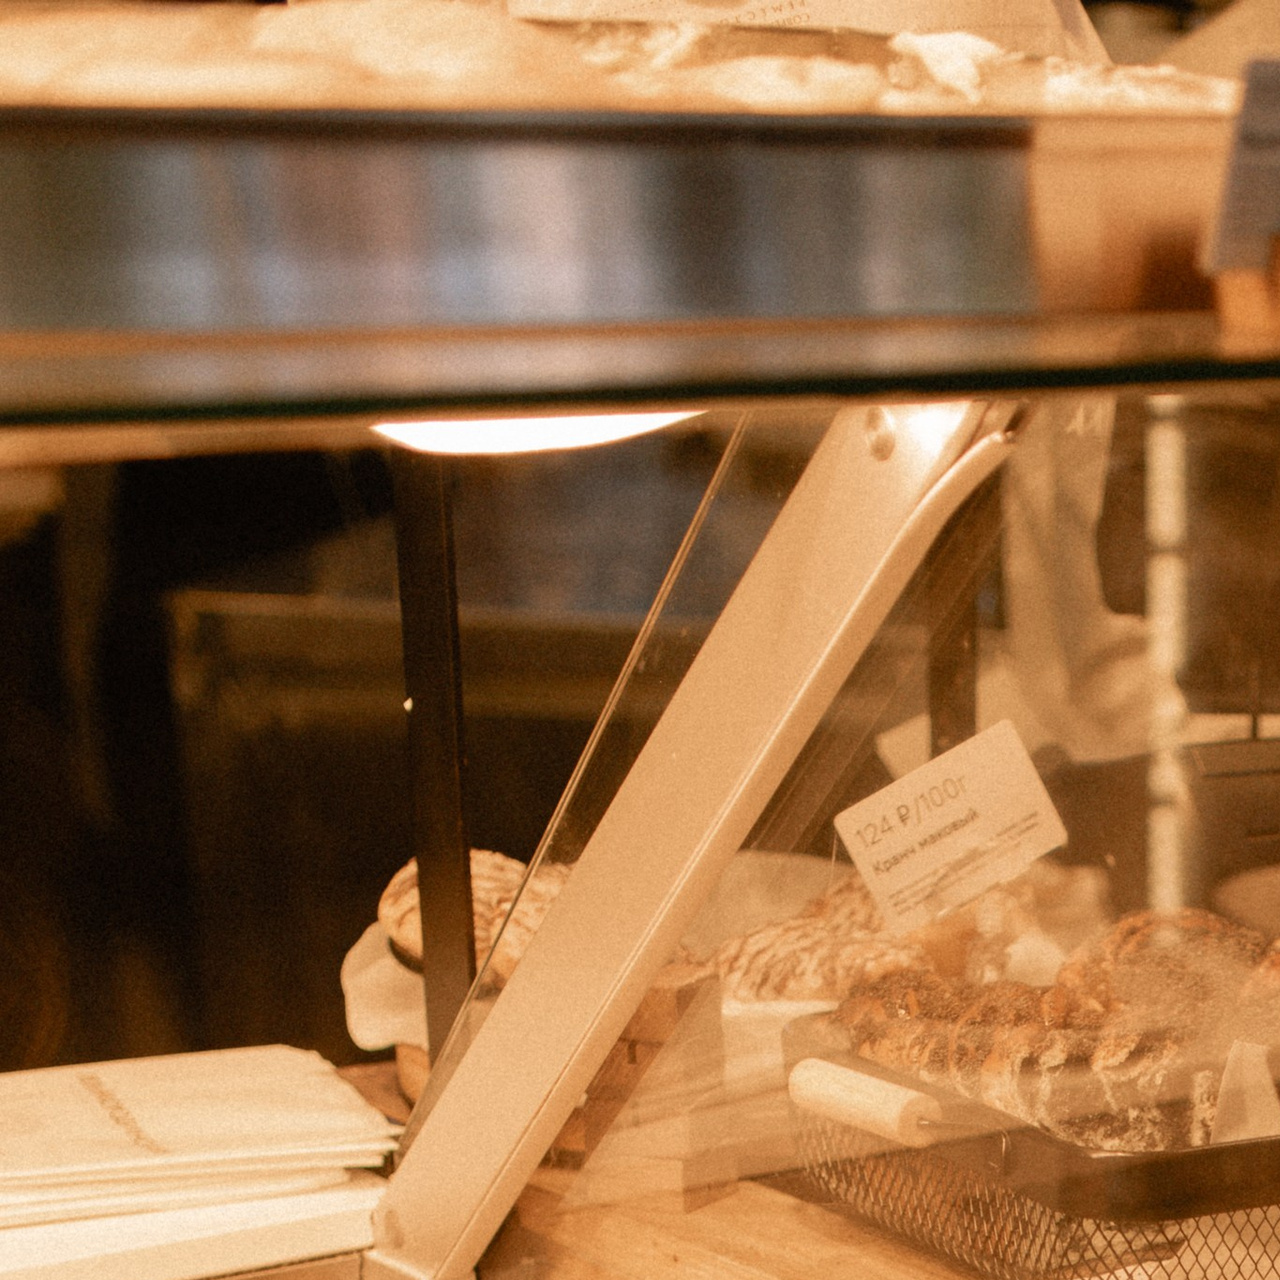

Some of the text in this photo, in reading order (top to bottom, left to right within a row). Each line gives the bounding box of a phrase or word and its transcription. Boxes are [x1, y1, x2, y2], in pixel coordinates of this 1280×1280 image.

[854, 815, 894, 849] 124
[872, 807, 980, 875] Кранч маковый
